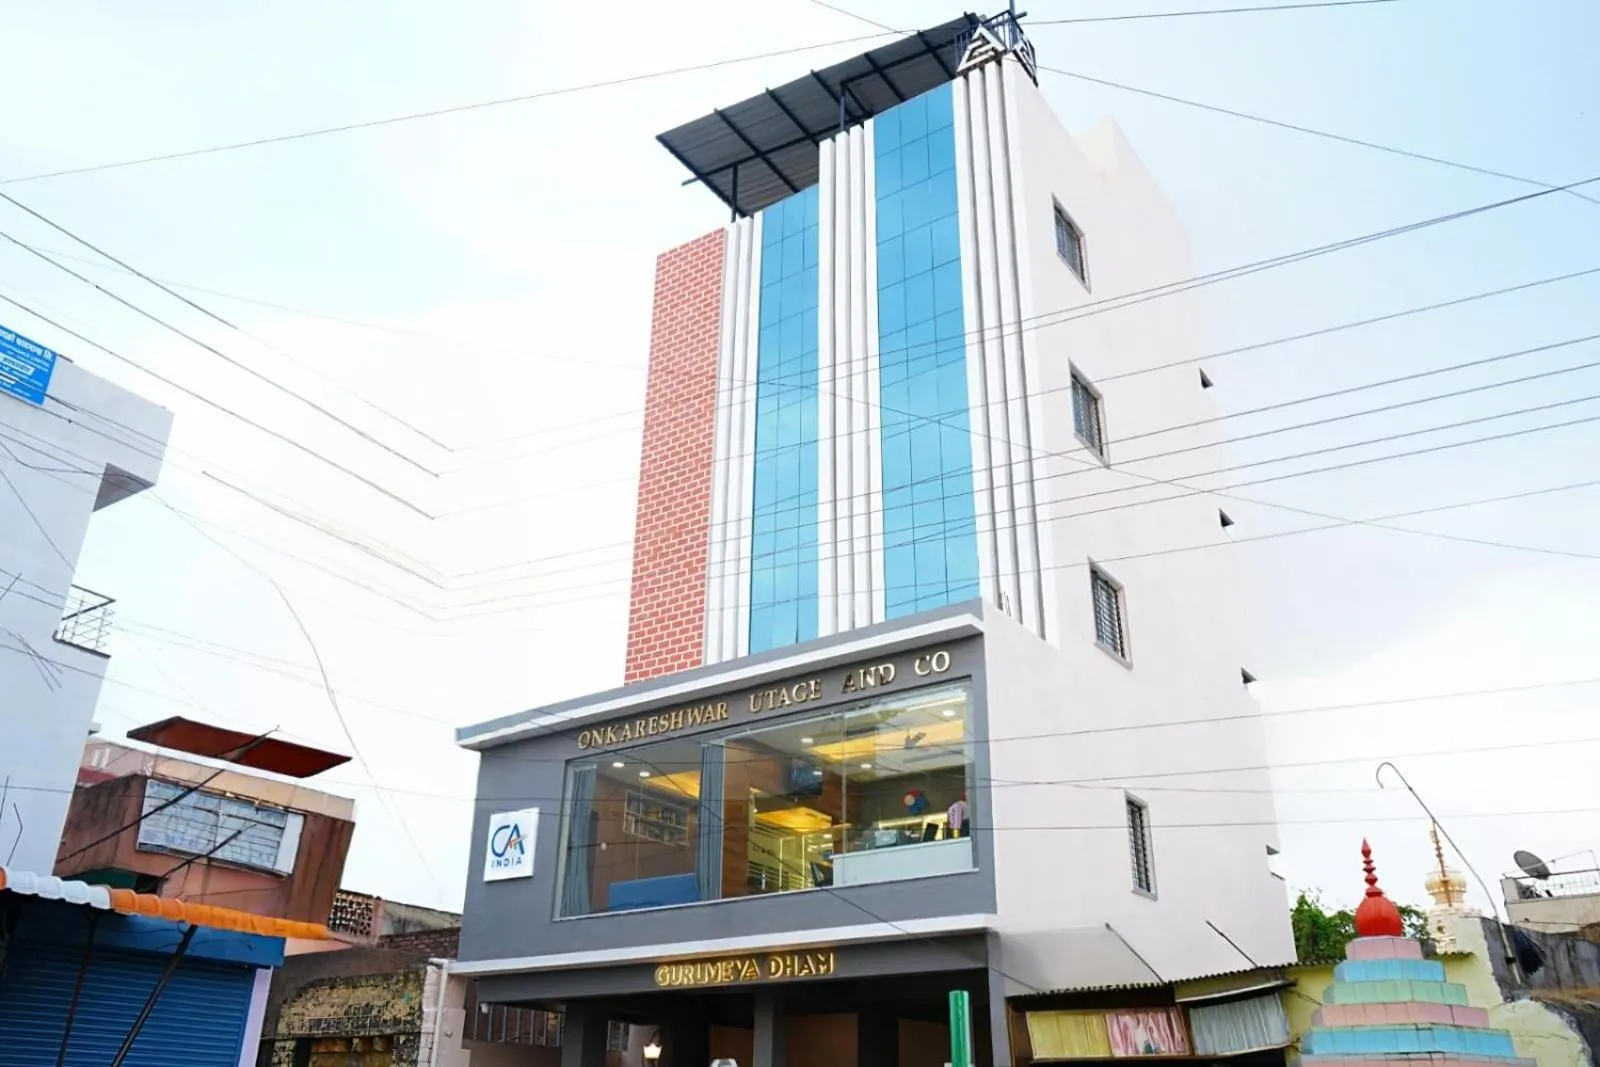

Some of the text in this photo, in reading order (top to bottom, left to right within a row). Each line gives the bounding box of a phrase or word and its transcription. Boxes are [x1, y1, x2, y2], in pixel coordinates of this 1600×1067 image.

[577, 650, 951, 750] ONKARESHWAR UTAGE AND CO
[491, 823, 525, 857] CA
[491, 857, 522, 868] INDIA
[768, 952, 836, 980] DHAM
